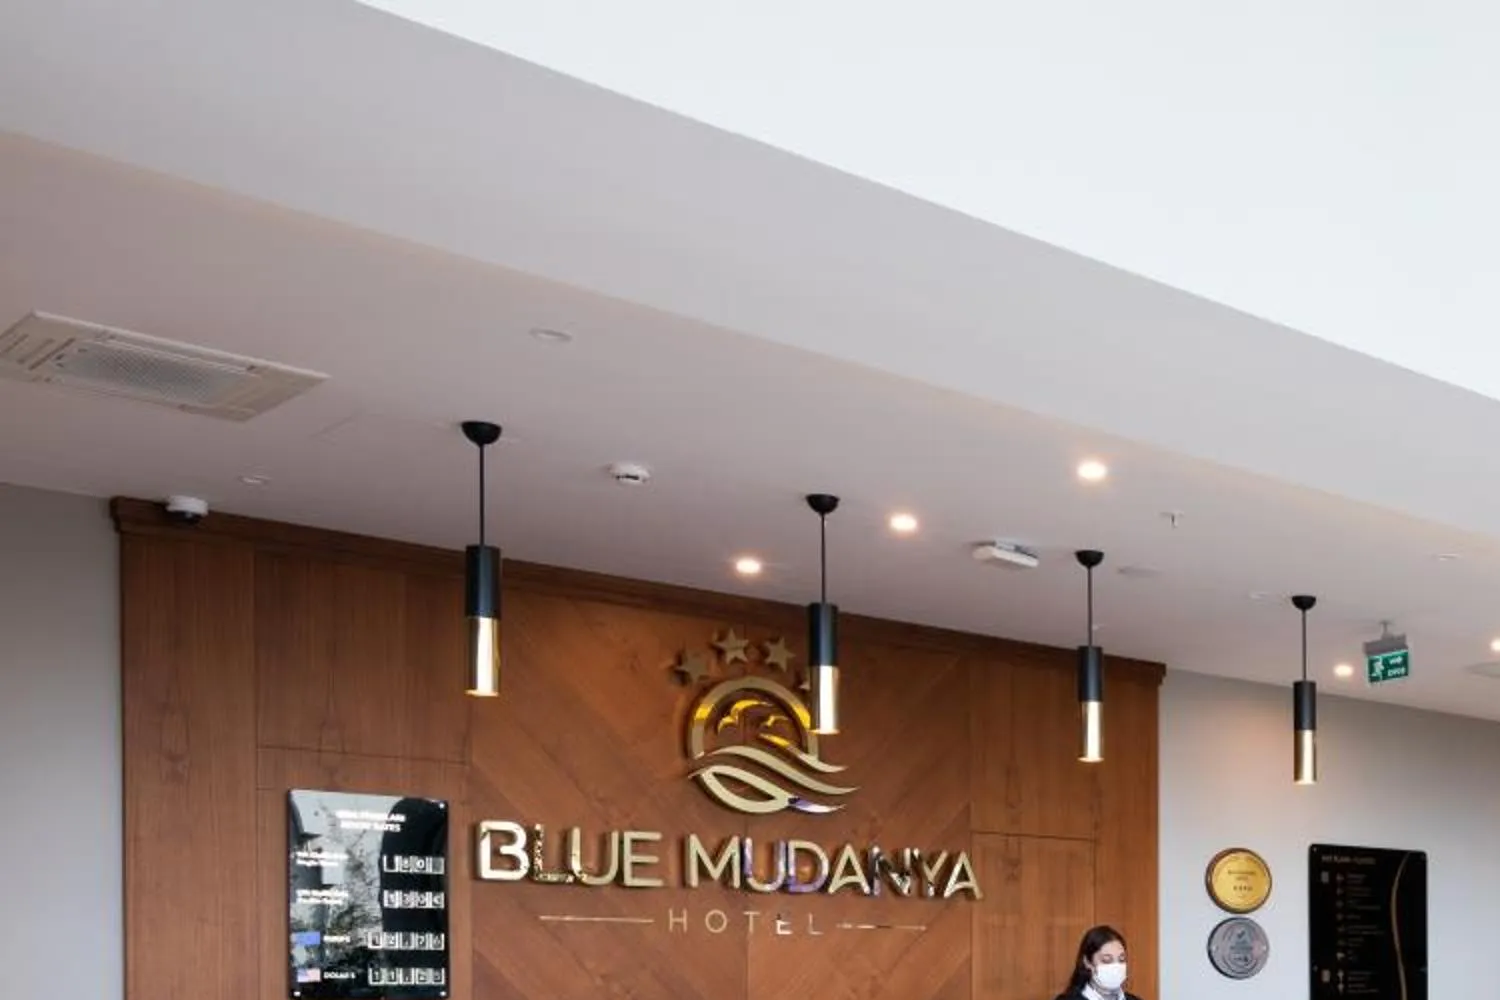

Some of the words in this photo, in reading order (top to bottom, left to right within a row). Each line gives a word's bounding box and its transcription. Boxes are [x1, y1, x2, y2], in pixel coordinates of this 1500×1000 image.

[476, 819, 664, 888] BLUE
[685, 833, 986, 901] MUDANYA
[668, 909, 825, 937] HOTEL
